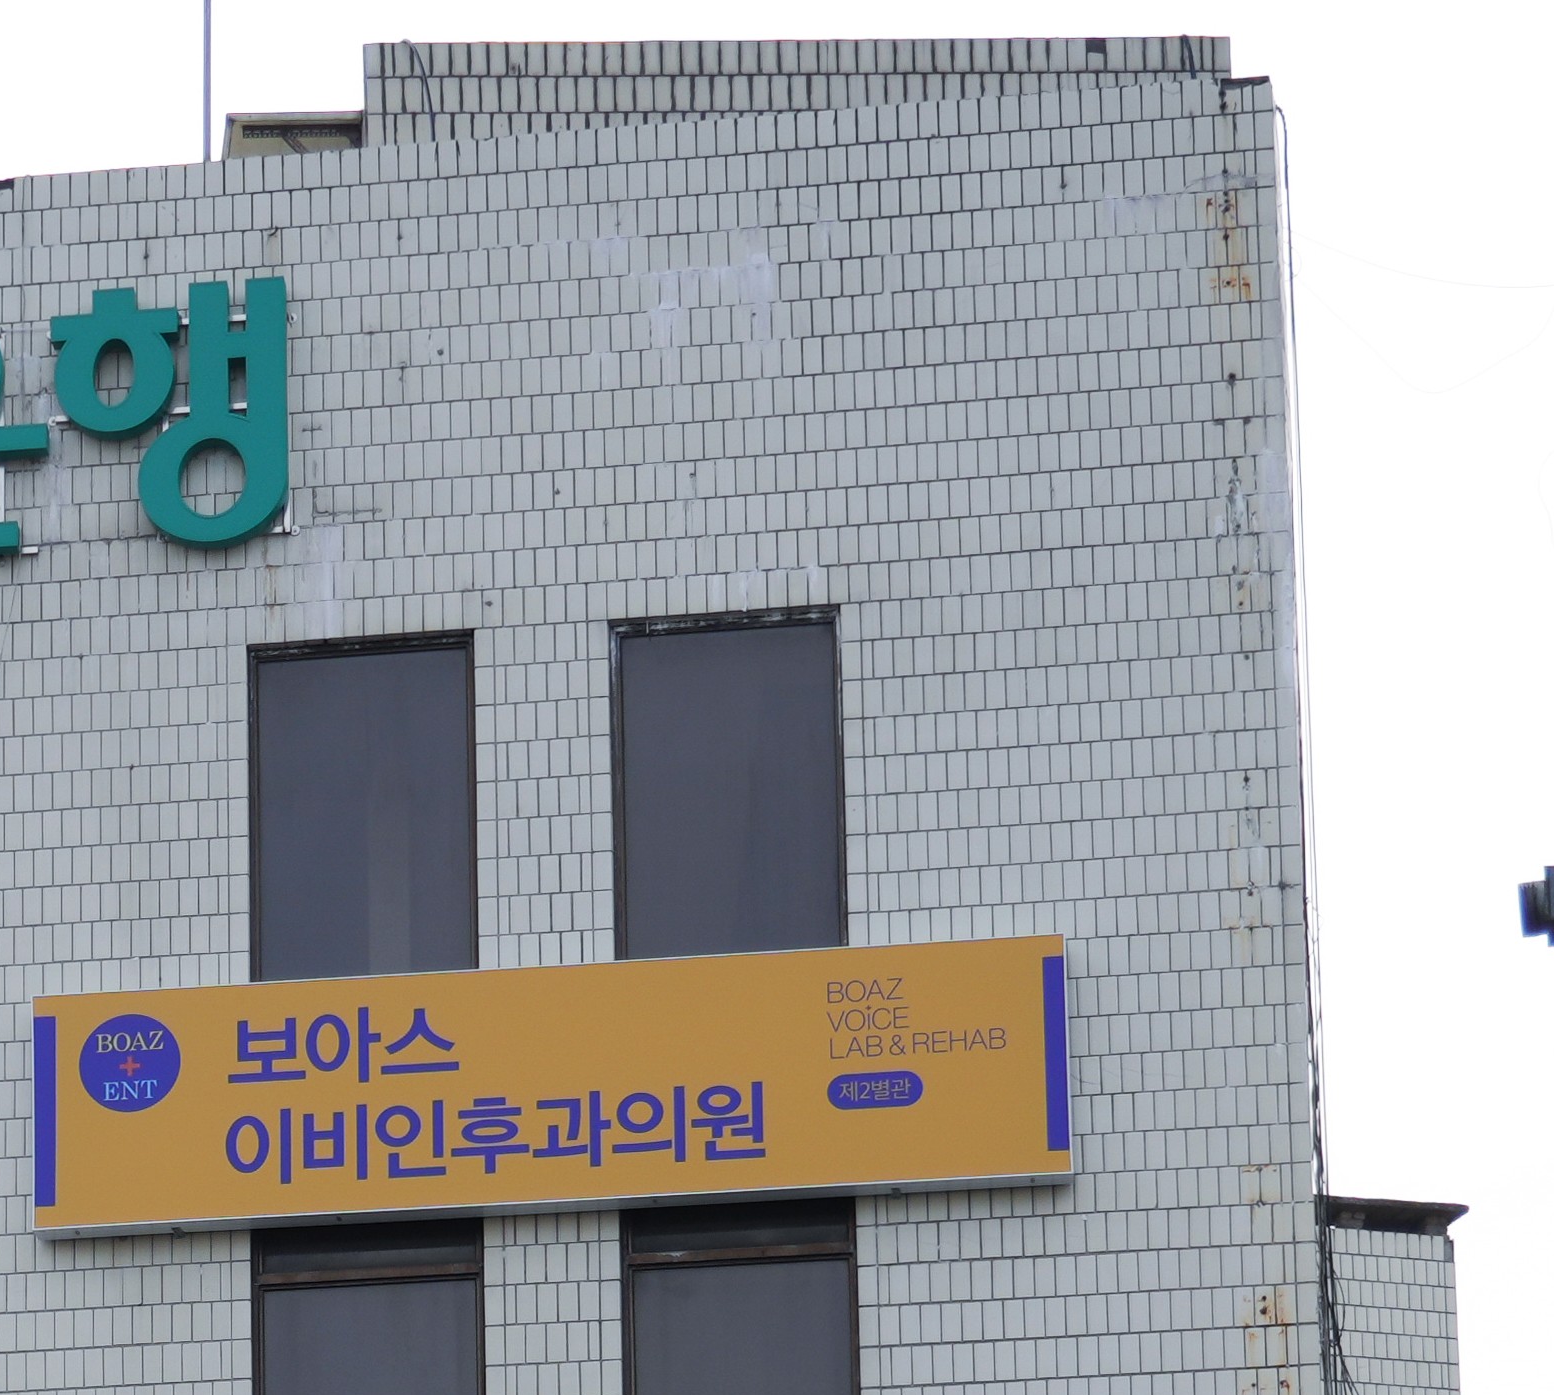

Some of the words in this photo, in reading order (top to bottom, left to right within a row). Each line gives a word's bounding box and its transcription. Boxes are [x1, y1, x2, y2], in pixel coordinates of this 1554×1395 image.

[827, 977, 904, 1004] BOAZ
[95, 1031, 164, 1055] BOAZ
[227, 1006, 460, 1086] 보아스
[829, 1034, 884, 1059] LAB
[890, 1033, 907, 1056] &
[912, 1026, 1008, 1054] REHAB
[102, 1078, 158, 1103] ENT
[838, 1076, 912, 1103] 제2별관
[224, 1082, 767, 1184] 이비인후과의원
